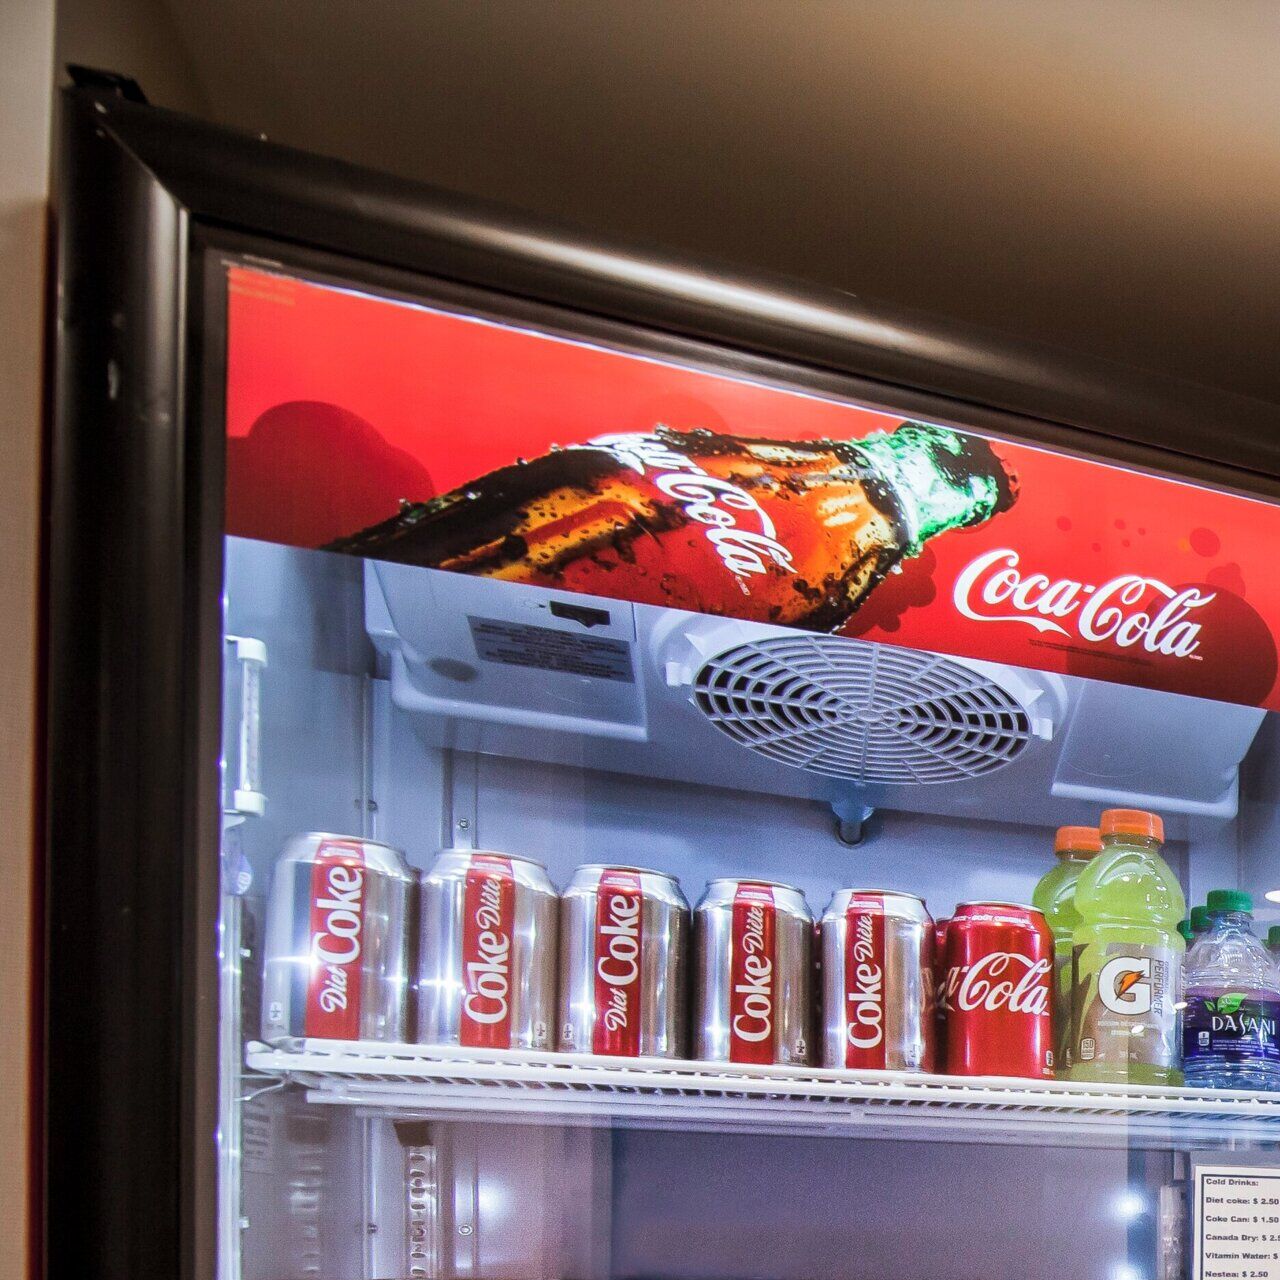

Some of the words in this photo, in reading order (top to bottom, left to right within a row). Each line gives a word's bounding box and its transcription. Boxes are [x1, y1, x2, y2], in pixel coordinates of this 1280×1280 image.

[953, 548, 1216, 658] Coca-Cola
[312, 865, 363, 965] Coke
[598, 894, 640, 986] Coke
[319, 965, 349, 1014] Diet
[464, 931, 511, 1025] Coke
[733, 955, 772, 1043] Coke
[1099, 956, 1151, 1015] G
[1153, 959, 1165, 1018] PERFORMER
[604, 987, 629, 1033] Diet
[847, 964, 882, 1049] Coke
[1211, 1014, 1276, 1036] DASANI
[1205, 1178, 1226, 1186] Cold
[1228, 1179, 1259, 1187] Drinks:
[1226, 1197, 1251, 1205] coke:
[1252, 1198, 1259, 1206] $
[1260, 1198, 1280, 1206] 2.50
[1205, 1215, 1228, 1223] Coke
[1252, 1216, 1259, 1224] $
[1260, 1216, 1280, 1224] 1.50
[1241, 1234, 1259, 1243] Dry:
[1261, 1234, 1267, 1242] $
[1205, 1252, 1240, 1260] Vitamin
[1242, 1252, 1271, 1260] Water:
[1273, 1252, 1279, 1260] $
[1242, 1270, 1248, 1278] $
